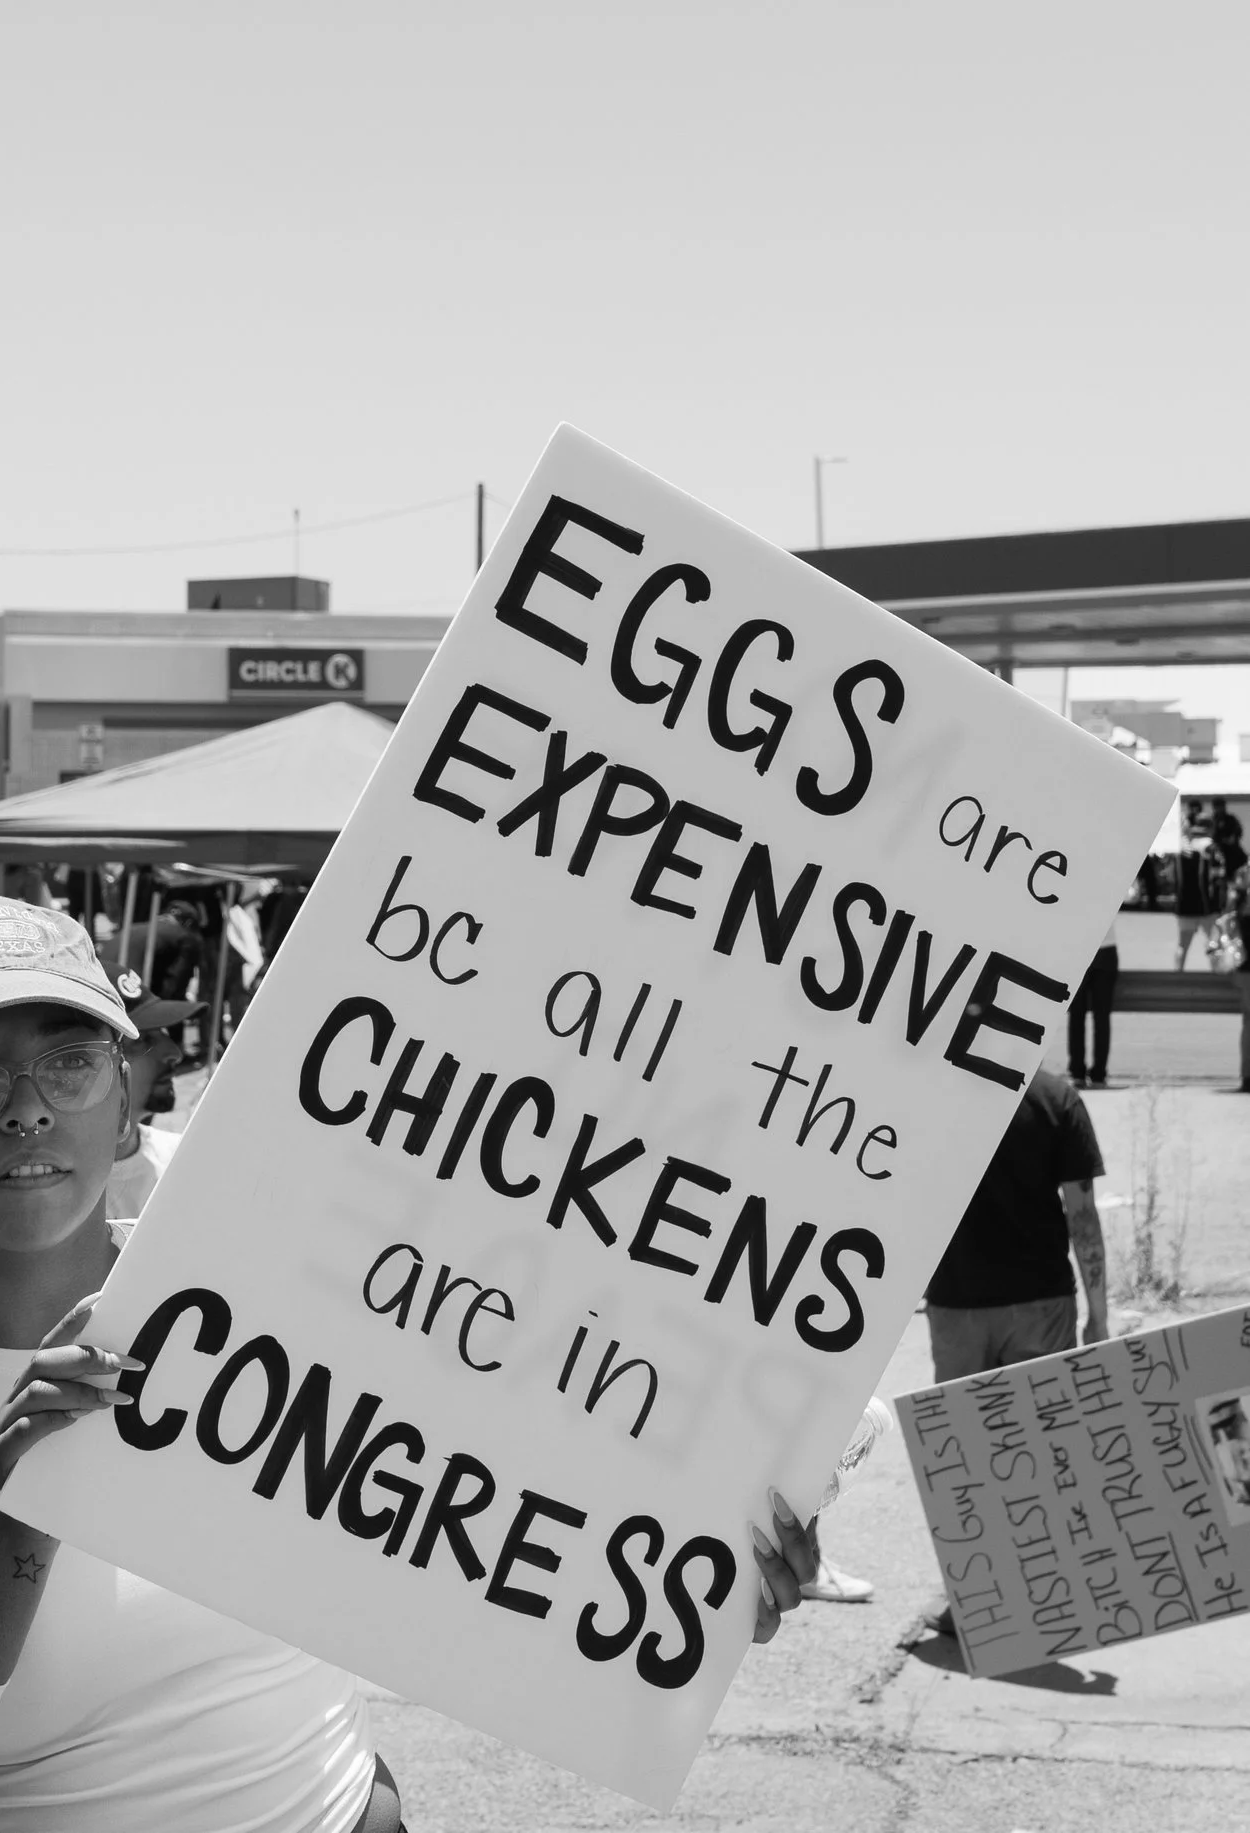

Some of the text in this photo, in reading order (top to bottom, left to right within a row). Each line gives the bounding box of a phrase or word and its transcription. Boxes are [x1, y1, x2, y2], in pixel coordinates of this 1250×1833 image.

[239, 653, 357, 689] CIRCLE K
[495, 495, 1068, 905] EGGS are
[413, 684, 1071, 1092] EXPENSIVE
[366, 856, 484, 986] bc
[545, 971, 683, 1082] all
[752, 1046, 897, 1180] the
[299, 997, 886, 1353] CHICKENS
[362, 1244, 658, 1439] are in
[910, 1387, 951, 1446] THE
[1028, 1374, 1080, 1433] MET
[1141, 1400, 1198, 1493] FUGLY
[116, 1288, 737, 1690] CONGRESS
[932, 1482, 985, 1542] Guy
[965, 1370, 1088, 1656] NASTIEST SKANK
[1049, 1441, 1077, 1495] Ever
[1063, 1347, 1196, 1631] DONT TRUST HIM
[1182, 1492, 1212, 1519] A
[946, 1552, 1020, 1671] THIS
[1203, 1571, 1250, 1620] He
